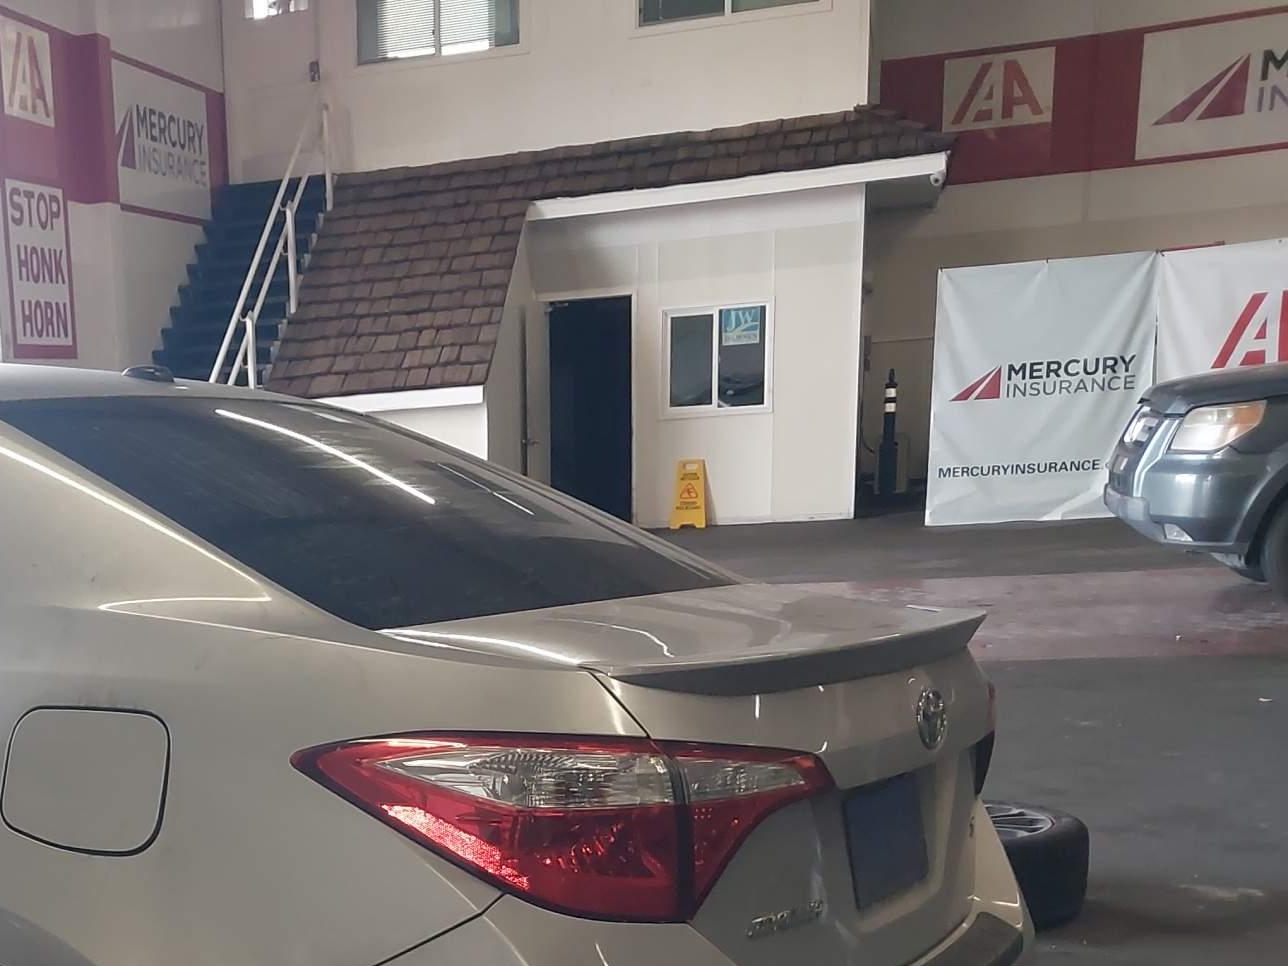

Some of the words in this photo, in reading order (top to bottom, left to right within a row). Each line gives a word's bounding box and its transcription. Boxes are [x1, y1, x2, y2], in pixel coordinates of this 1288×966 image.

[135, 103, 204, 155] MERCURY
[137, 144, 207, 187] INSURANCE
[9, 187, 61, 231] STOP
[17, 244, 66, 284] HONK
[21, 299, 69, 338] HORN
[1006, 374, 1137, 398] INSURANCE
[1007, 354, 1137, 381] MERCURY
